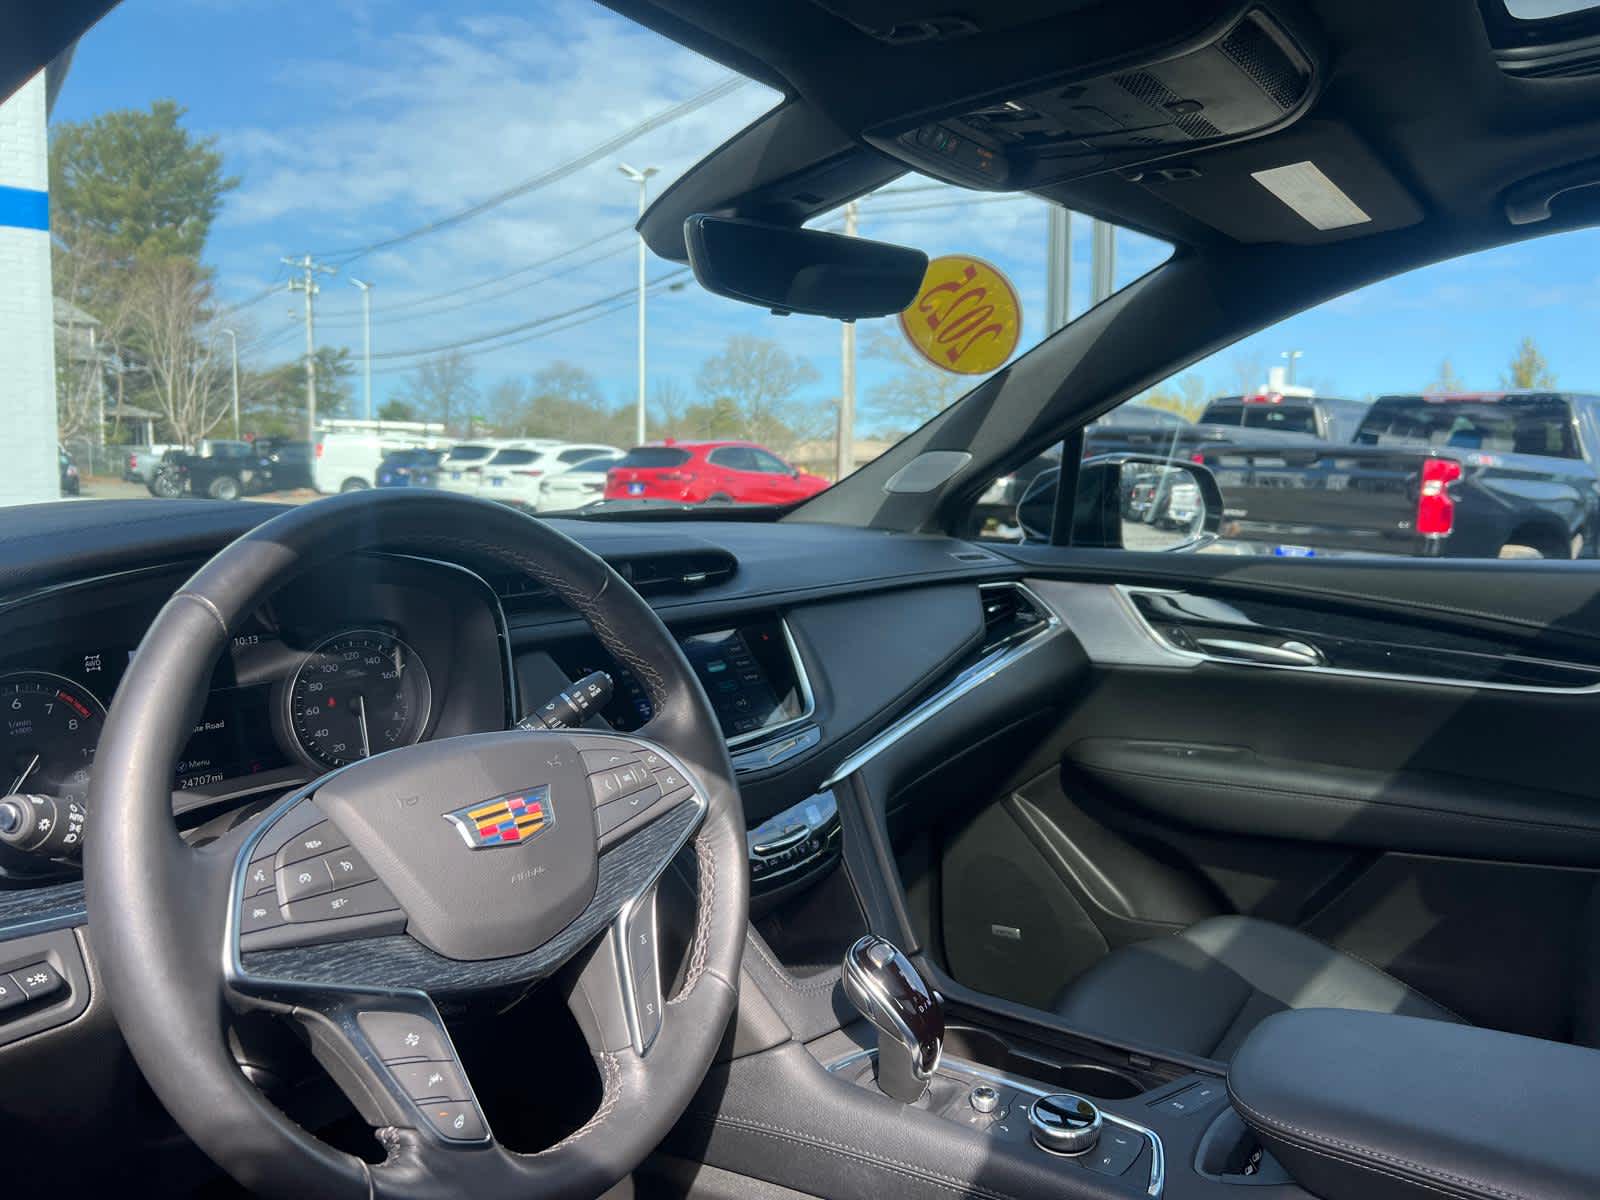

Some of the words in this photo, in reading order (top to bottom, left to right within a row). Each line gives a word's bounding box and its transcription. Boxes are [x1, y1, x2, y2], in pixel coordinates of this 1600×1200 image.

[234, 635, 258, 646] 10:13
[343, 651, 360, 660] 120
[365, 655, 381, 665] 140
[320, 663, 338, 672] 100
[382, 670, 399, 679] 160
[308, 682, 323, 691] 80
[11, 698, 22, 710] 6
[45, 703, 54, 715] 7
[306, 706, 320, 716] 60
[68, 719, 79, 730] 8
[205, 720, 225, 731] Road
[315, 728, 329, 737] 40
[333, 743, 346, 753] 20
[189, 760, 210, 768] Menu
[181, 773, 224, 789] 24707mi
